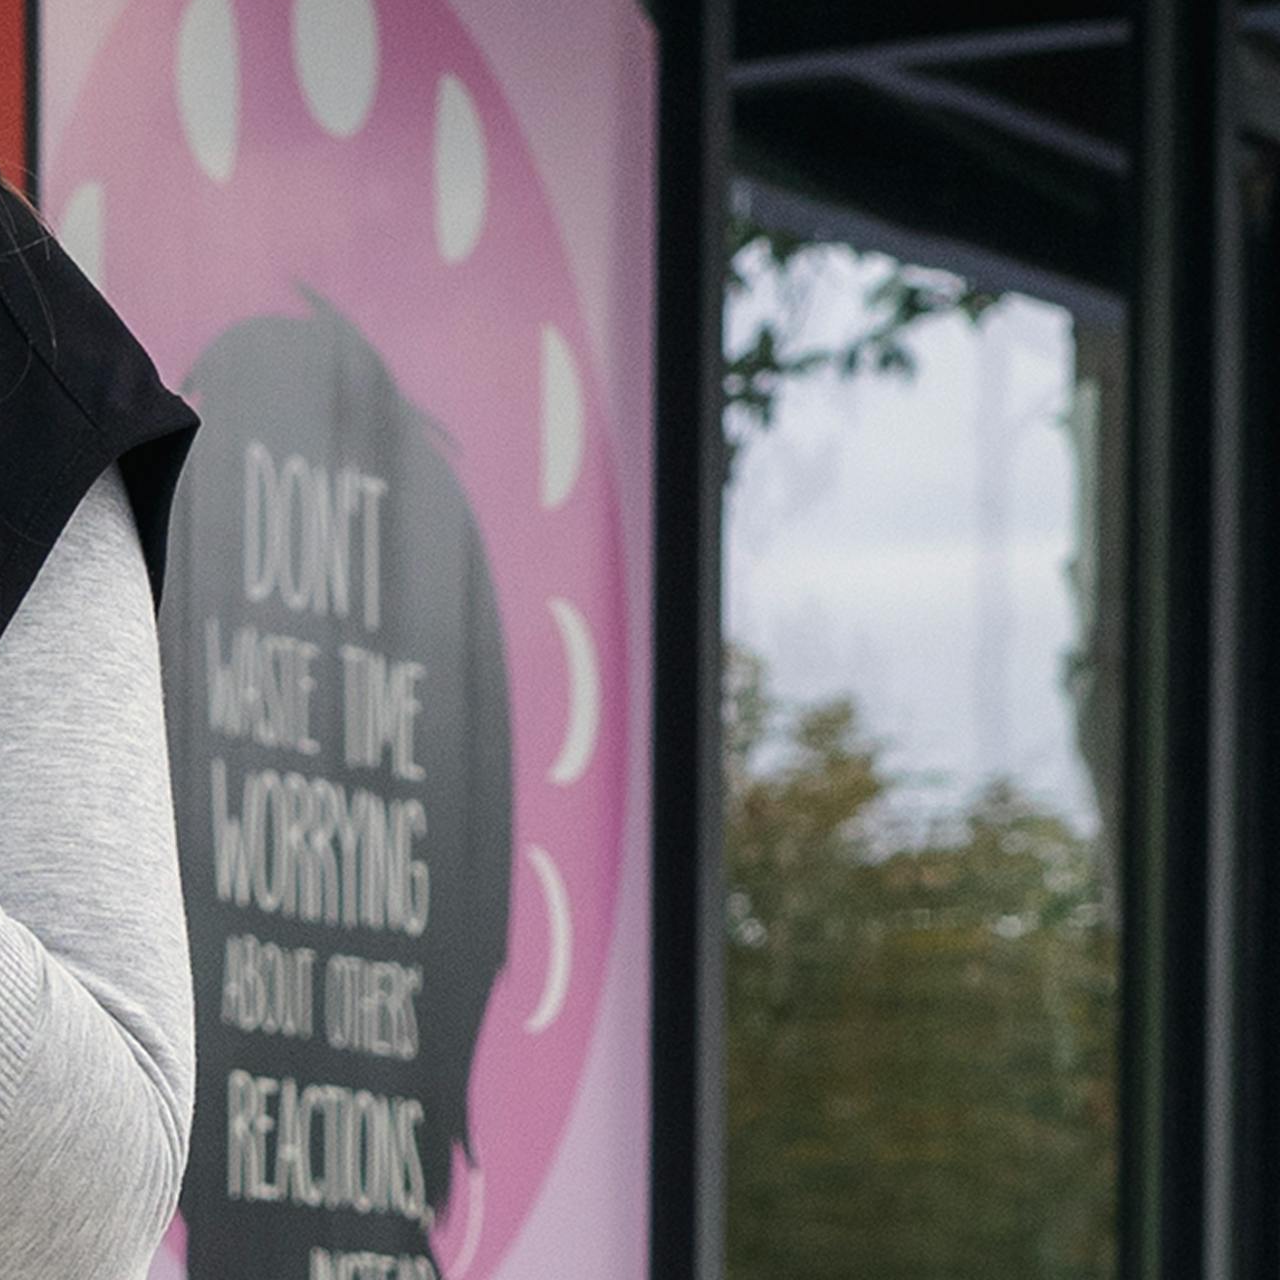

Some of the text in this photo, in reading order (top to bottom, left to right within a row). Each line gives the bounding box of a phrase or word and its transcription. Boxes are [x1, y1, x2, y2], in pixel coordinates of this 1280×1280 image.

[243, 440, 388, 632] DON'T
[205, 615, 427, 782] WASTE TIME
[210, 756, 430, 937] WORRYING
[221, 933, 424, 1061] ABOUT OTHERS
